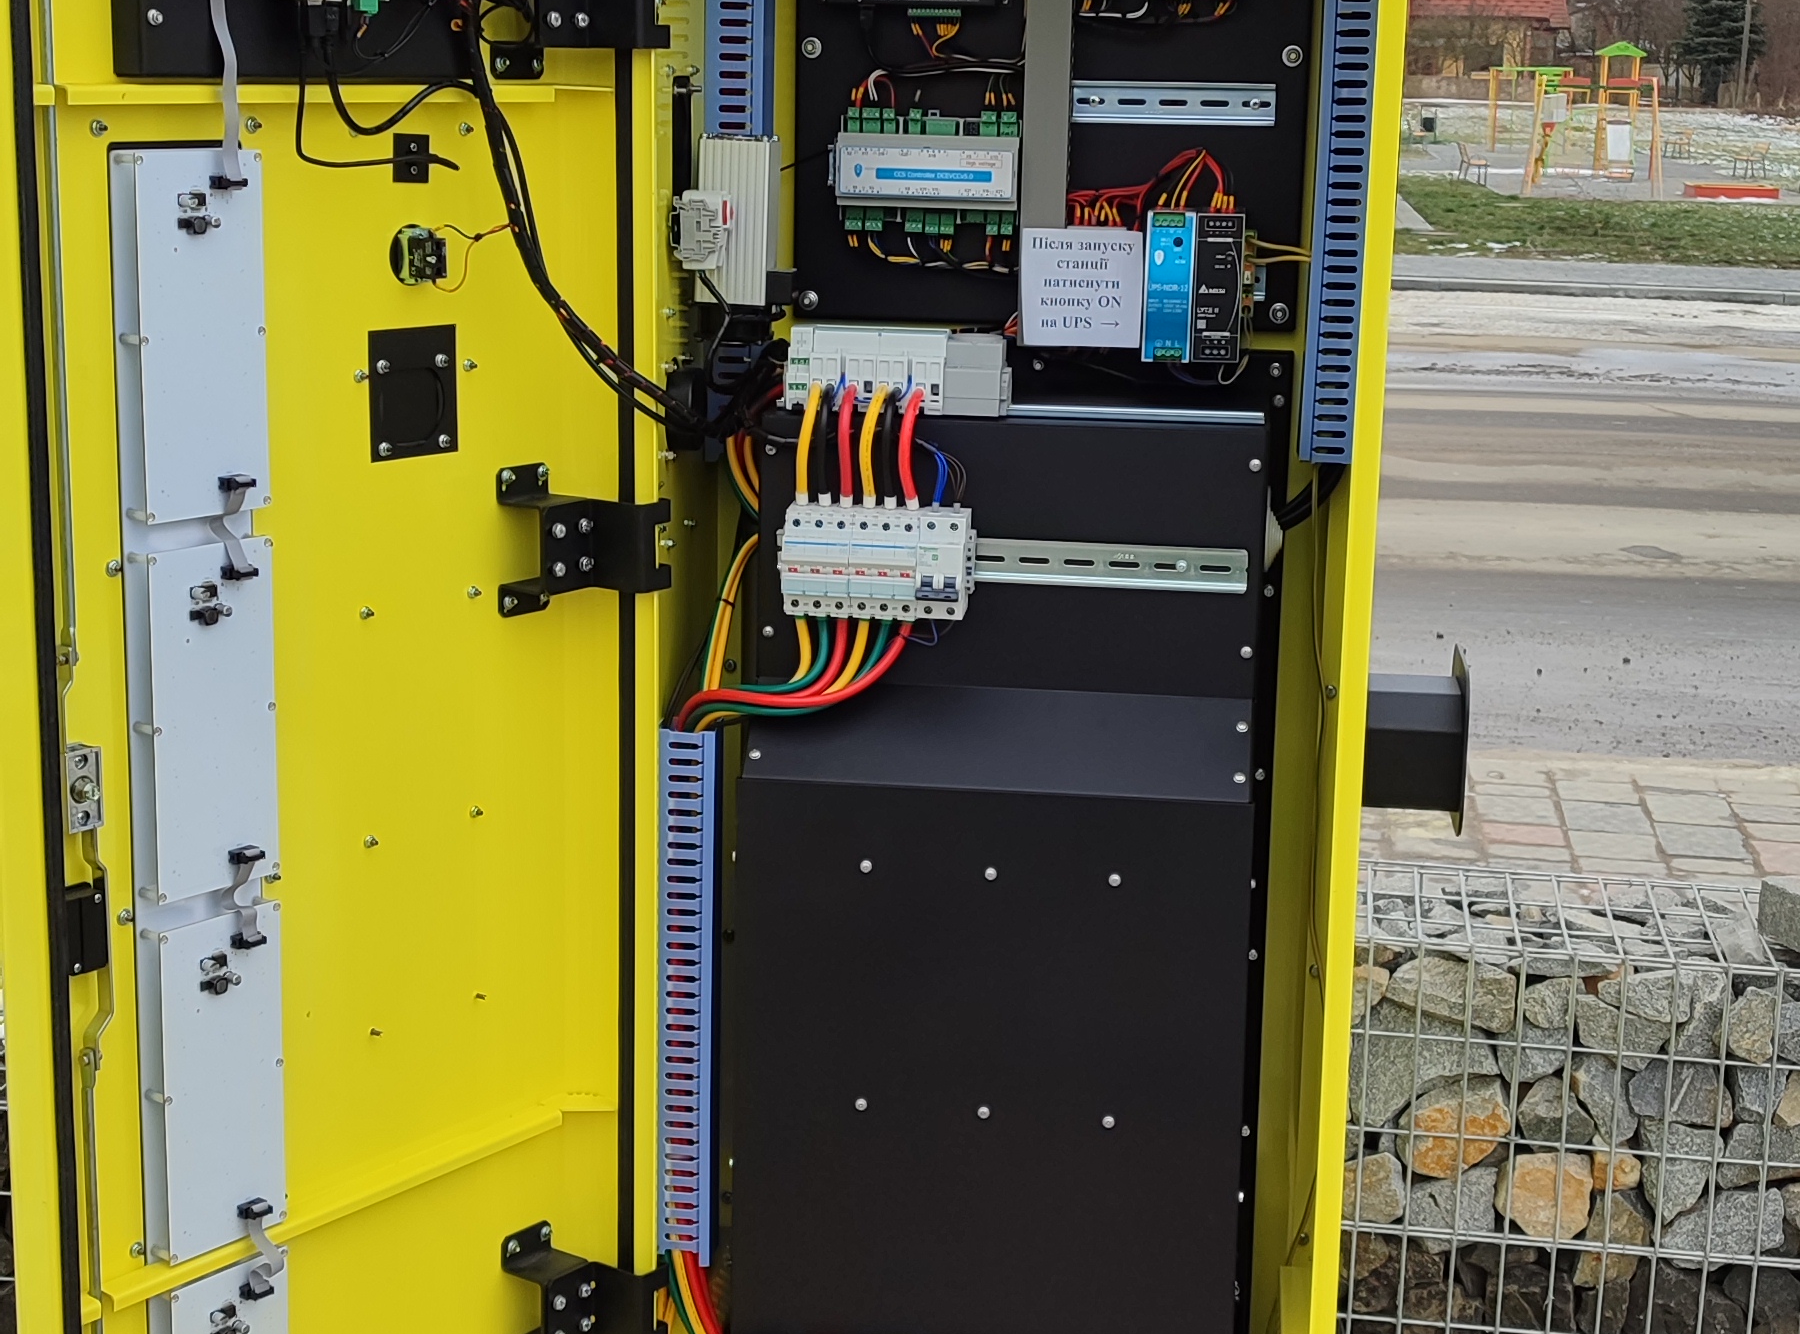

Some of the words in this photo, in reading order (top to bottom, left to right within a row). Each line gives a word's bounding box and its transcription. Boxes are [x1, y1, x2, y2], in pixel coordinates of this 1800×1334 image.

[907, 171, 936, 179] Controller
[1032, 236, 1073, 250] Після
[1077, 240, 1135, 256] запуску
[1056, 257, 1110, 271] станції
[1043, 278, 1120, 292] натиснути
[1040, 296, 1093, 310] кнопку
[1098, 295, 1122, 308] ON
[1041, 318, 1057, 328] на
[1062, 316, 1092, 329] UPS
